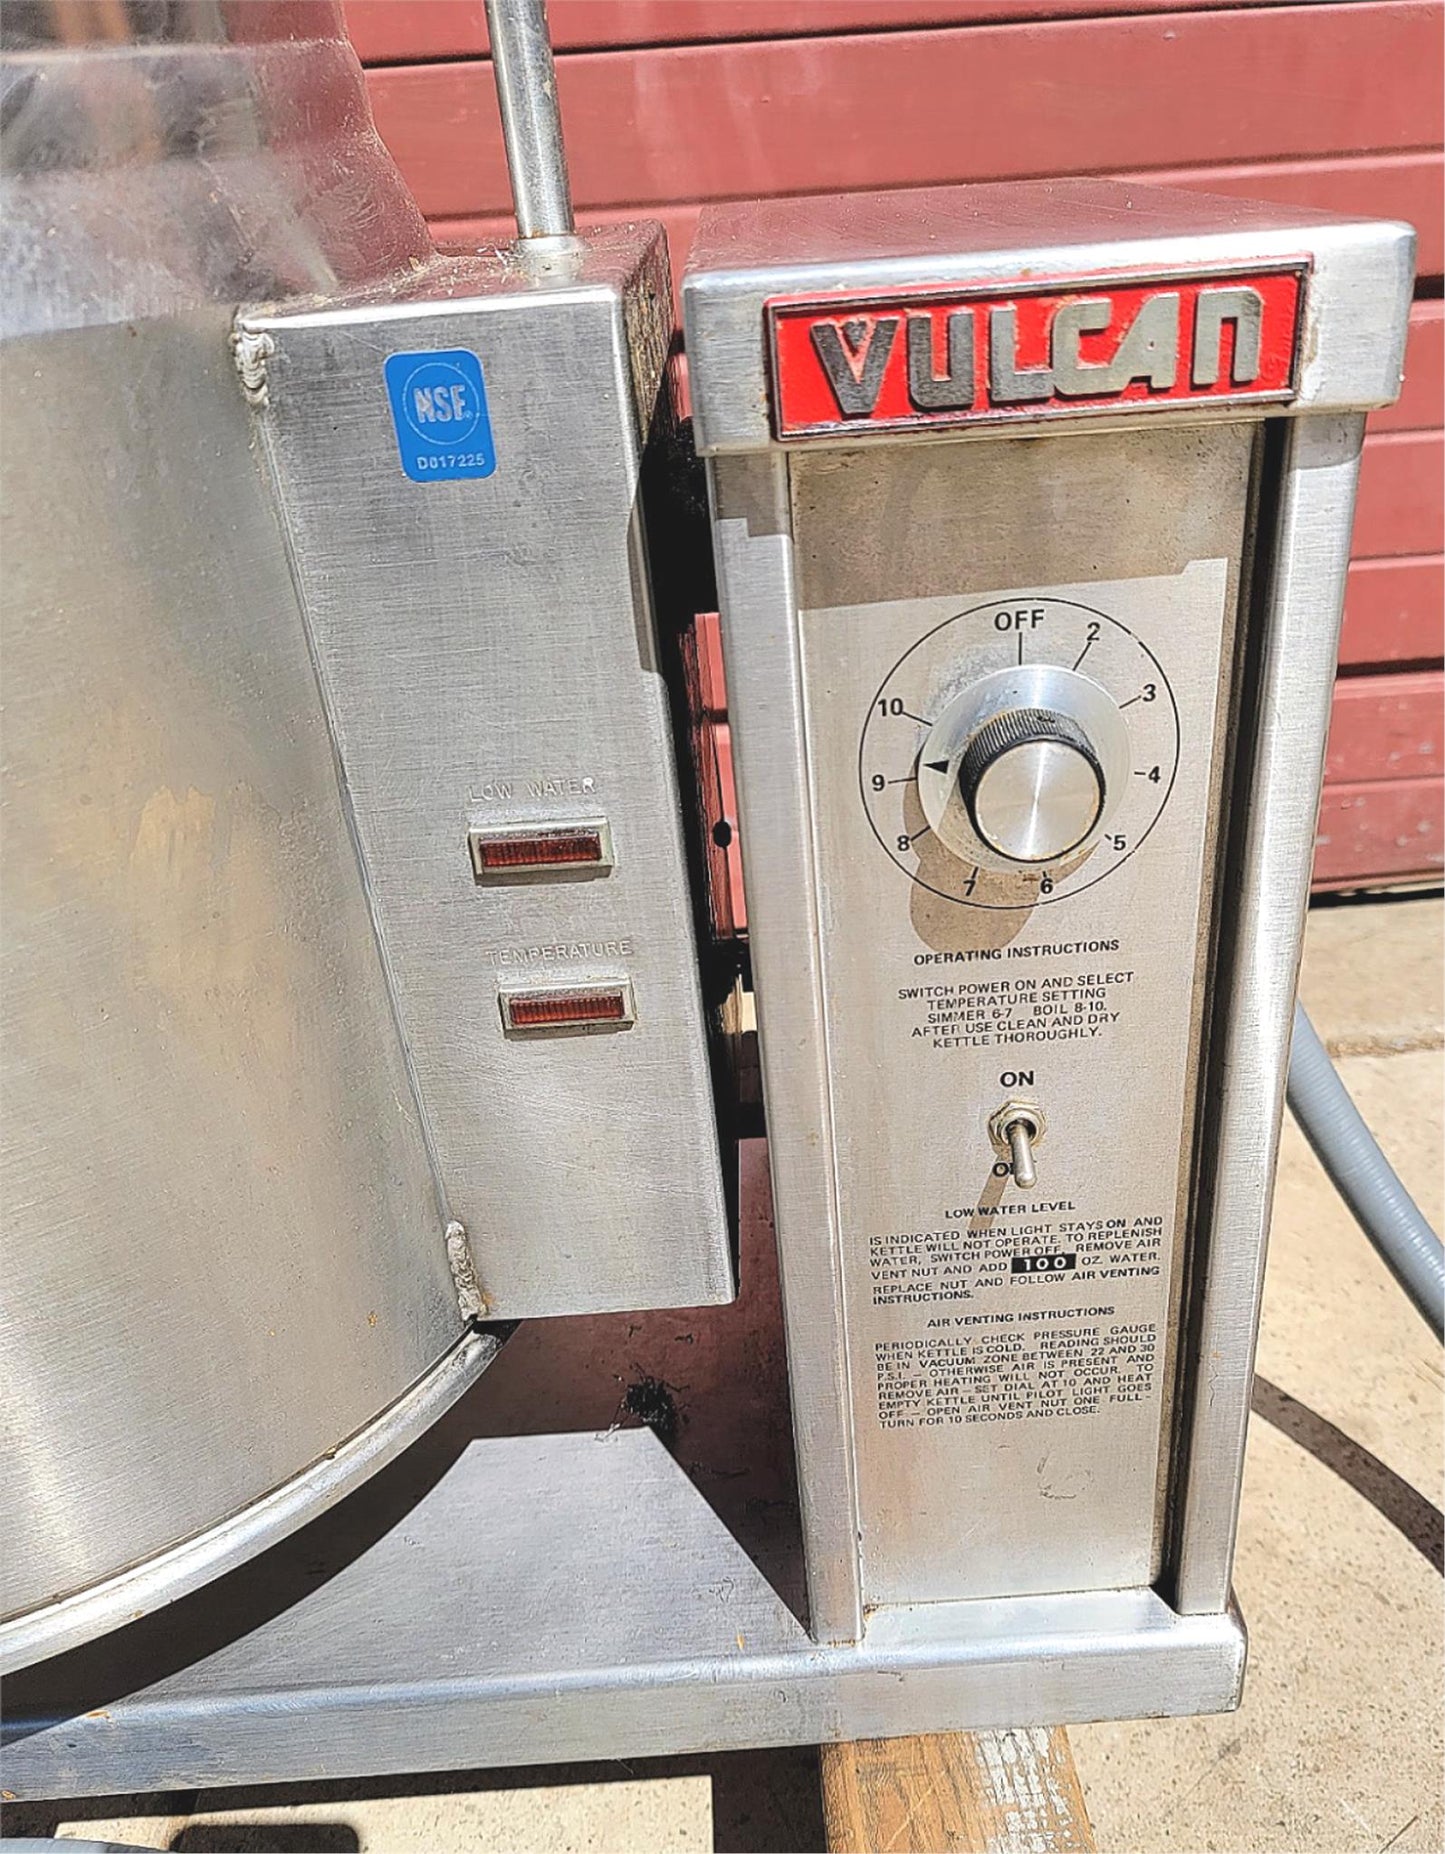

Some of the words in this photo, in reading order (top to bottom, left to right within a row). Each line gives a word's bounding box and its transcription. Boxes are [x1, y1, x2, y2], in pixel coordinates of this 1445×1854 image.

[810, 286, 1262, 415] VULCAN
[413, 384, 465, 423] NSF
[417, 453, 485, 470] D017225
[994, 609, 1045, 631] OFF
[1086, 622, 1100, 641] 2
[1143, 684, 1157, 702] 3
[878, 698, 903, 717] 10
[871, 775, 885, 791] 9
[1148, 766, 1161, 783] 4
[468, 783, 512, 802] LOW
[526, 777, 596, 797] WATER
[897, 835, 910, 851] 8
[1113, 835, 1126, 851] 5
[963, 880, 976, 897] 7
[1041, 878, 1053, 894] 6
[486, 940, 633, 966] TEMPERATURE
[914, 949, 1001, 966] OPERATING
[1007, 939, 1120, 958] INSTRUCTIONS
[898, 986, 954, 1000] SWITCH
[959, 982, 1010, 995] POWER
[1015, 980, 1036, 991] ON
[1041, 977, 1073, 989] AND
[1077, 971, 1134, 986] SELECT
[928, 995, 1037, 1011] TEMPERATURE
[1042, 987, 1106, 1002] SETTING
[928, 1010, 985, 1024] SIMMER
[992, 1008, 1012, 1019] 6-7
[1034, 1005, 1067, 1015] BOIL
[965, 1022, 993, 1033] USE
[996, 1019, 1047, 1031] CLEAN
[1051, 1016, 1083, 1027] AND
[1088, 1012, 1120, 1025] DRY
[933, 1038, 990, 1049] KETTLE
[995, 1026, 1102, 1044] THOROUGHLY.
[1000, 1071, 1034, 1087] ON
[945, 1208, 974, 1219] LOW
[978, 1204, 1026, 1216] WATER
[1032, 1202, 1076, 1214] LEVEL
[870, 1237, 881, 1245] IS
[886, 1231, 960, 1244] INDICATED
[967, 1228, 1006, 1238] WHEN
[1011, 1224, 1052, 1235] LIGHT
[1059, 1221, 1102, 1232] STAYS
[1106, 1219, 1126, 1228] ON
[1134, 1216, 1163, 1227] AND
[870, 1245, 922, 1257] KETTLE
[926, 1243, 959, 1252] WILL
[963, 1240, 992, 1250] NOT
[996, 1235, 1061, 1248] OPERATE.
[1067, 1233, 1083, 1242] TO
[1088, 1227, 1162, 1240] REPLENISH
[870, 1255, 921, 1267] WATER,
[931, 1252, 980, 1263] SWITCH
[984, 1248, 1031, 1258] POWER
[1076, 1241, 1132, 1252] REMOVE
[1137, 1238, 1161, 1248] AIR
[871, 1270, 907, 1280] VENT
[912, 1267, 939, 1277] NUT
[944, 1265, 972, 1275] AND
[979, 1262, 1008, 1273] ADD
[1024, 1256, 1066, 1271] 100
[1110, 1252, 1160, 1263] WATER.
[873, 1282, 932, 1294] REPLACE
[940, 1280, 968, 1290] NUT
[975, 1277, 1003, 1287] AND
[1010, 1273, 1065, 1285] FOLLOW
[1072, 1271, 1095, 1281] AIR
[1100, 1266, 1160, 1279] VENTING
[873, 1290, 974, 1305] INSTRUCTIONS.
[927, 1319, 950, 1328] AIR
[955, 1314, 1014, 1325] VENTING
[1018, 1306, 1115, 1321] INSTRUCTIONS
[876, 1337, 972, 1351] PERIODICALLY
[982, 1332, 1025, 1344] CHECK
[1034, 1327, 1100, 1339] PRESSURE
[1110, 1324, 1156, 1334] GAUGE
[876, 1352, 913, 1361] WHEN
[918, 1347, 967, 1358] KETTLE
[973, 1346, 983, 1354] IS
[986, 1344, 1025, 1353] COLD.
[1040, 1338, 1099, 1349] READING
[1104, 1334, 1156, 1345] SHOULD
[877, 1363, 892, 1371] BE
[920, 1357, 975, 1368] VACUUM
[984, 1353, 1019, 1364] ZONE
[1022, 1349, 1083, 1361] BETWEEN
[1091, 1348, 1104, 1356] 22
[1109, 1345, 1136, 1354] AND
[1140, 1344, 1155, 1352] 30
[930, 1365, 1004, 1377] OTHERWISE
[1012, 1362, 1035, 1371] AIR
[1044, 1361, 1055, 1369] IS
[1061, 1356, 1118, 1368] PRESENT
[1127, 1354, 1155, 1363] AND
[878, 1380, 927, 1390] PROPER
[934, 1376, 991, 1387] HEATING
[999, 1372, 1031, 1382] WILL
[1039, 1370, 1065, 1379] NOT
[1074, 1366, 1120, 1376] OCCUR.
[1137, 1364, 1154, 1372] TO
[879, 1389, 932, 1400] REMOVE
[936, 1387, 959, 1396] AIR
[975, 1385, 998, 1393] SET
[1004, 1382, 1034, 1392] DIAL
[1042, 1380, 1058, 1389] AT
[1084, 1376, 1111, 1386] AND
[1117, 1373, 1152, 1383] HEAT
[879, 1400, 921, 1410] EMPTY
[927, 1396, 975, 1406] KETTLE
[981, 1391, 1020, 1402] UNTIL
[1027, 1389, 1063, 1399] PILOT
[1072, 1386, 1110, 1396] LIGHT
[1118, 1383, 1152, 1393] GOES
[879, 1410, 903, 1419] OFF
[927, 1407, 960, 1416] OPEN
[968, 1404, 990, 1413] AIR
[999, 1402, 1033, 1411] VENT
[1041, 1398, 1067, 1408] NUT
[1074, 1396, 1100, 1405] ONE
[880, 1419, 914, 1429] TURN
[920, 1417, 944, 1426] FOR
[966, 1410, 1023, 1423] SECONDS
[1026, 1409, 1053, 1418] AND
[1056, 1406, 1100, 1416] CLOSE.
